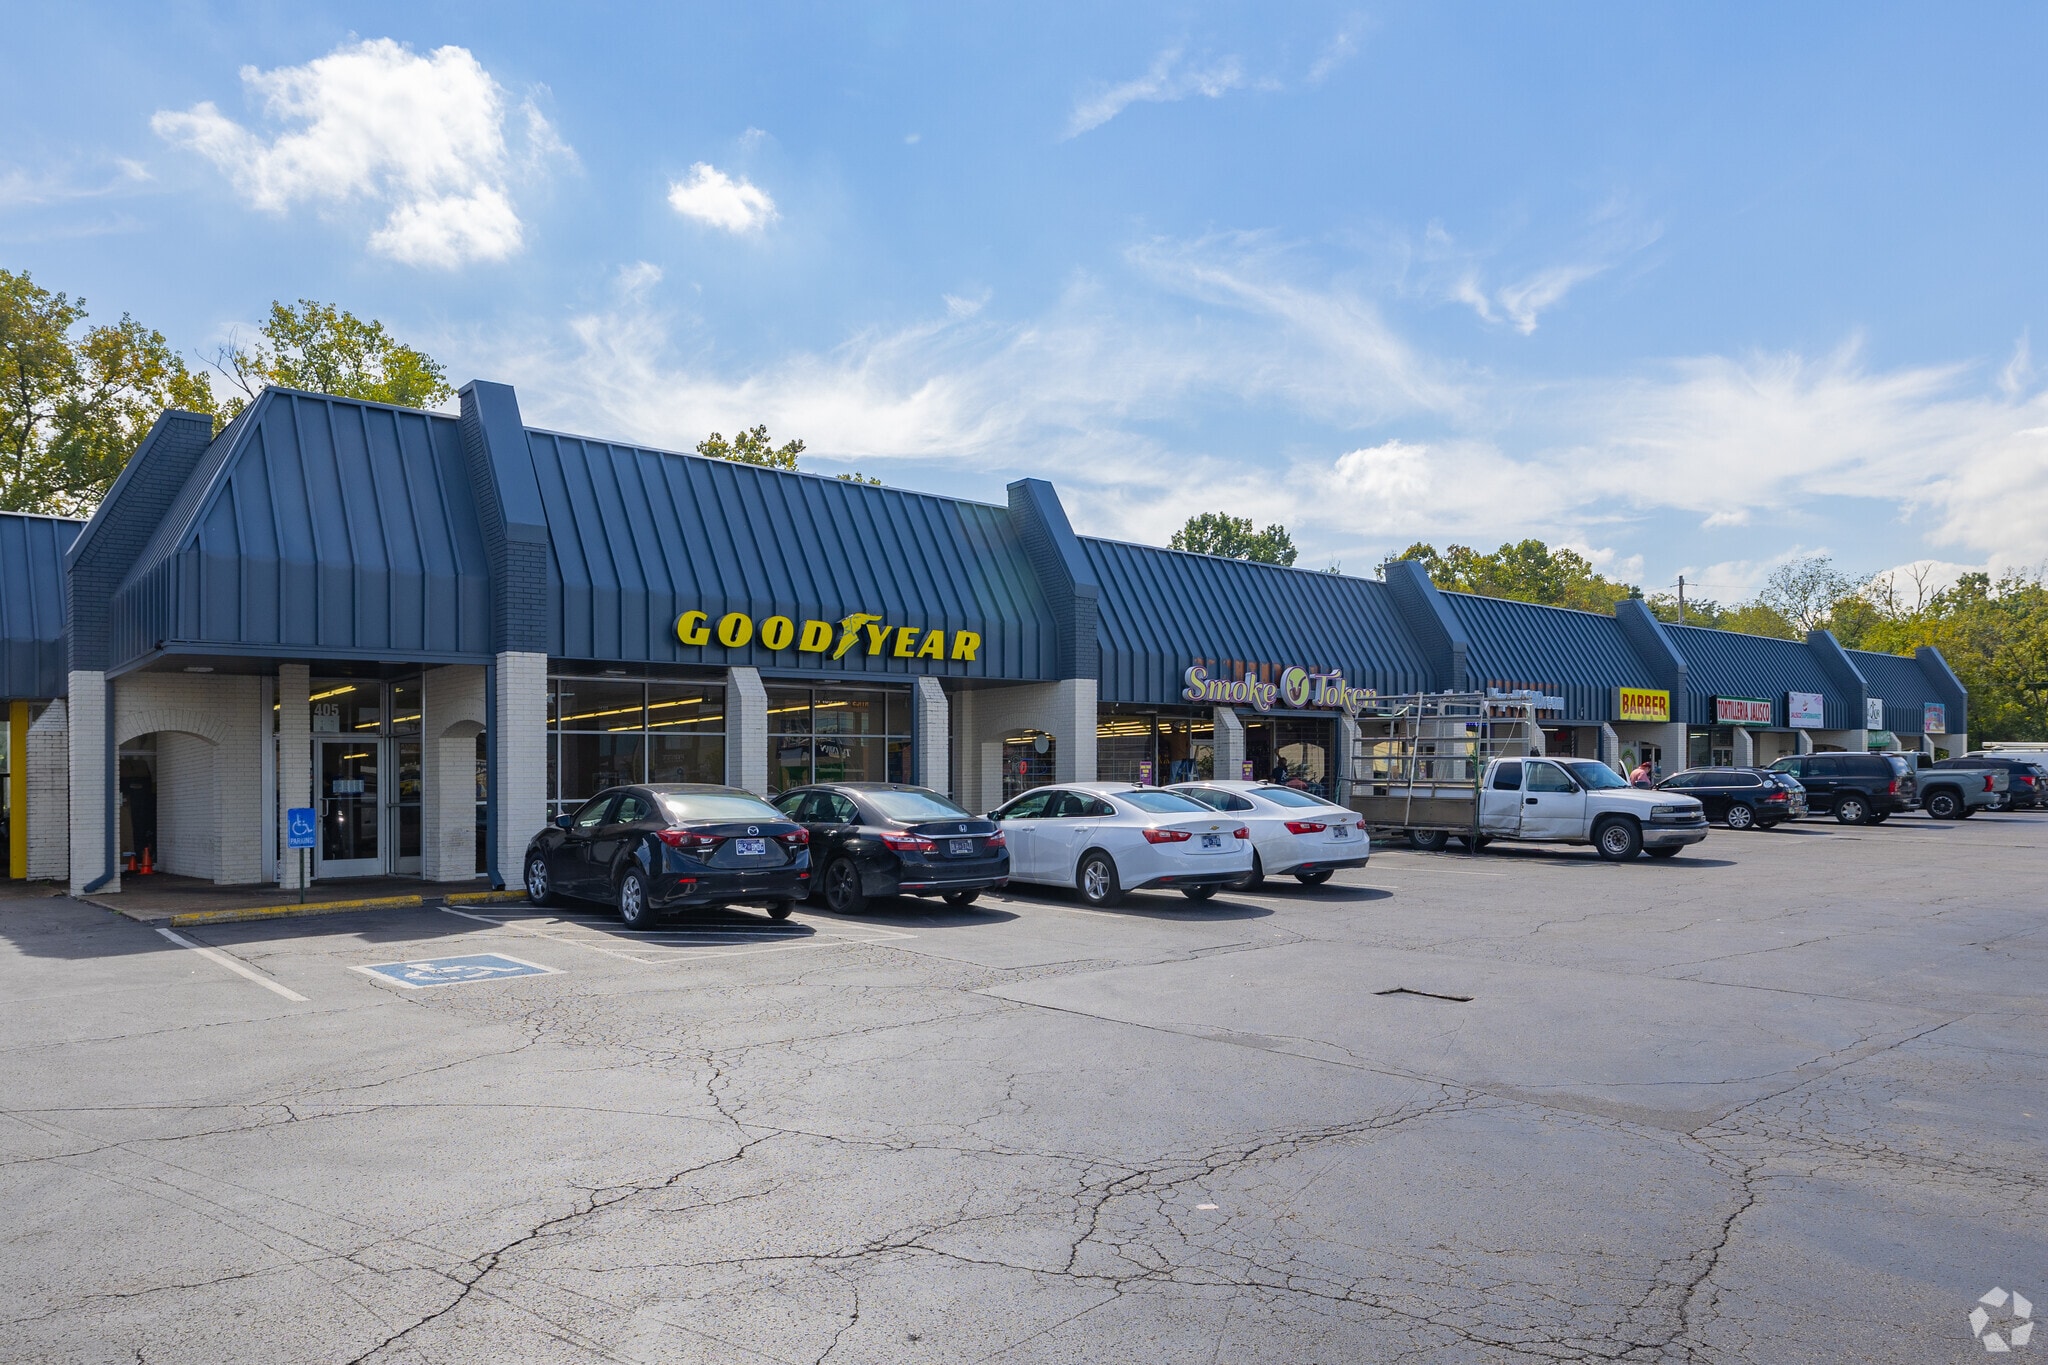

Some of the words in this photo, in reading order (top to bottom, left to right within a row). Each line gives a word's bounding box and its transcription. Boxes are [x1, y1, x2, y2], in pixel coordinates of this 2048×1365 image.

[1186, 666, 1277, 711] Smoke
[1311, 669, 1378, 713] Token
[314, 703, 339, 716] 405
[1622, 693, 1666, 715] BARBER
[1717, 699, 1748, 720] TORTILLERIA
[1750, 702, 1770, 722] JALISCO
[290, 837, 314, 845] PARKING
